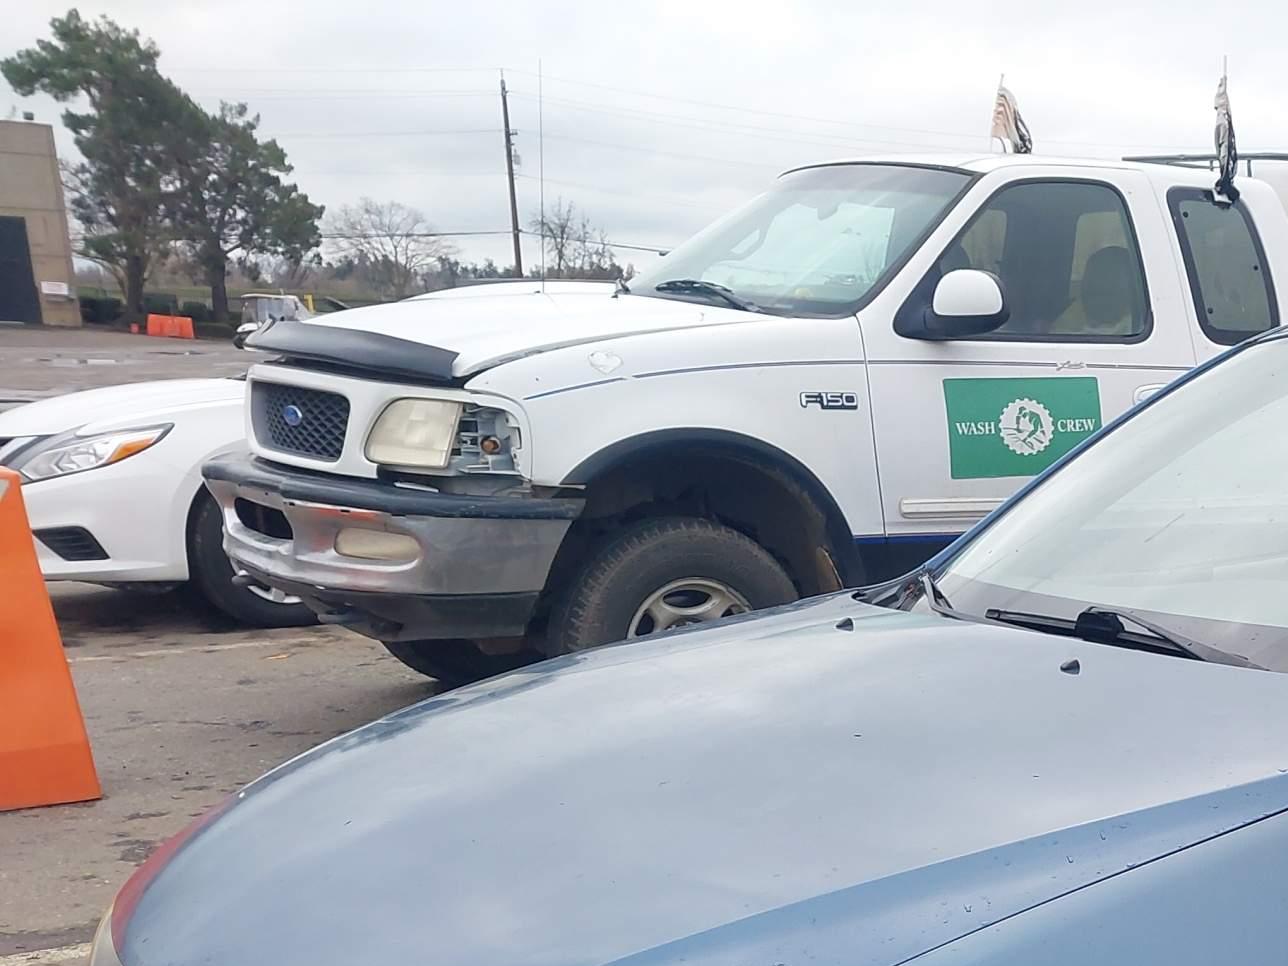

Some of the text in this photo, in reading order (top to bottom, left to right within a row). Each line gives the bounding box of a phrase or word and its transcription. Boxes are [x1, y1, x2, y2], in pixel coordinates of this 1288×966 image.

[800, 391, 858, 410] F-150
[955, 418, 1096, 436] WASH CREW
